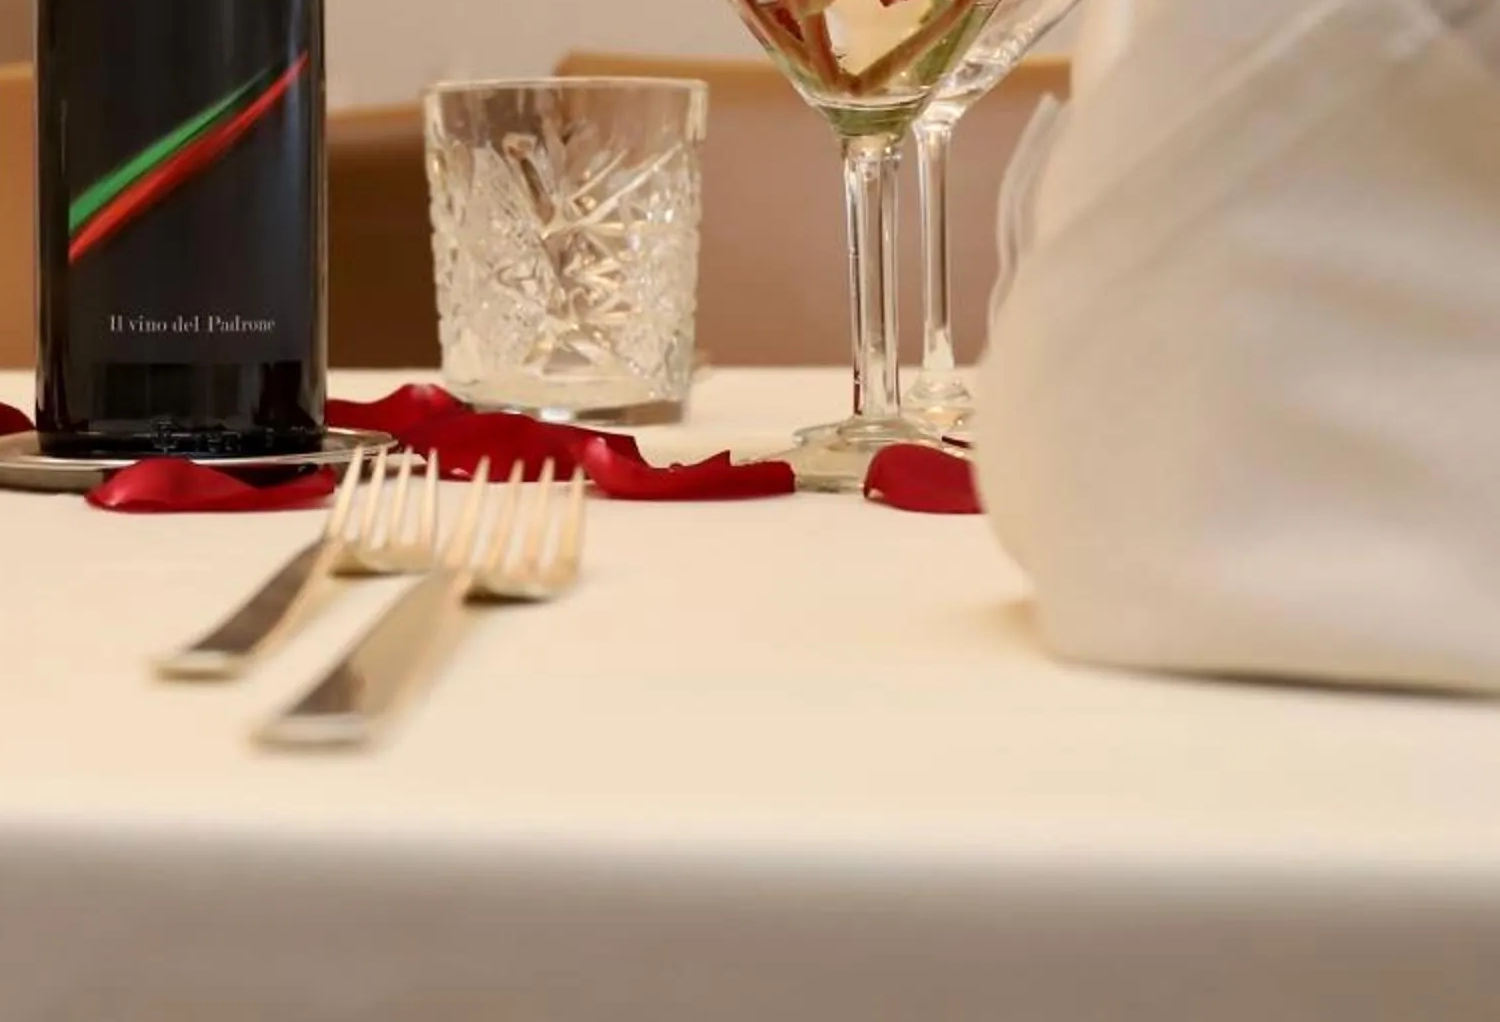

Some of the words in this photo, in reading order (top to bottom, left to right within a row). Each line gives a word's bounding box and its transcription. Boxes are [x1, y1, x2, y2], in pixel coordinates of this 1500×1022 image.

[110, 314, 123, 333] Il
[129, 314, 168, 332] vino
[172, 314, 200, 333] del
[208, 314, 276, 333] Padrone
